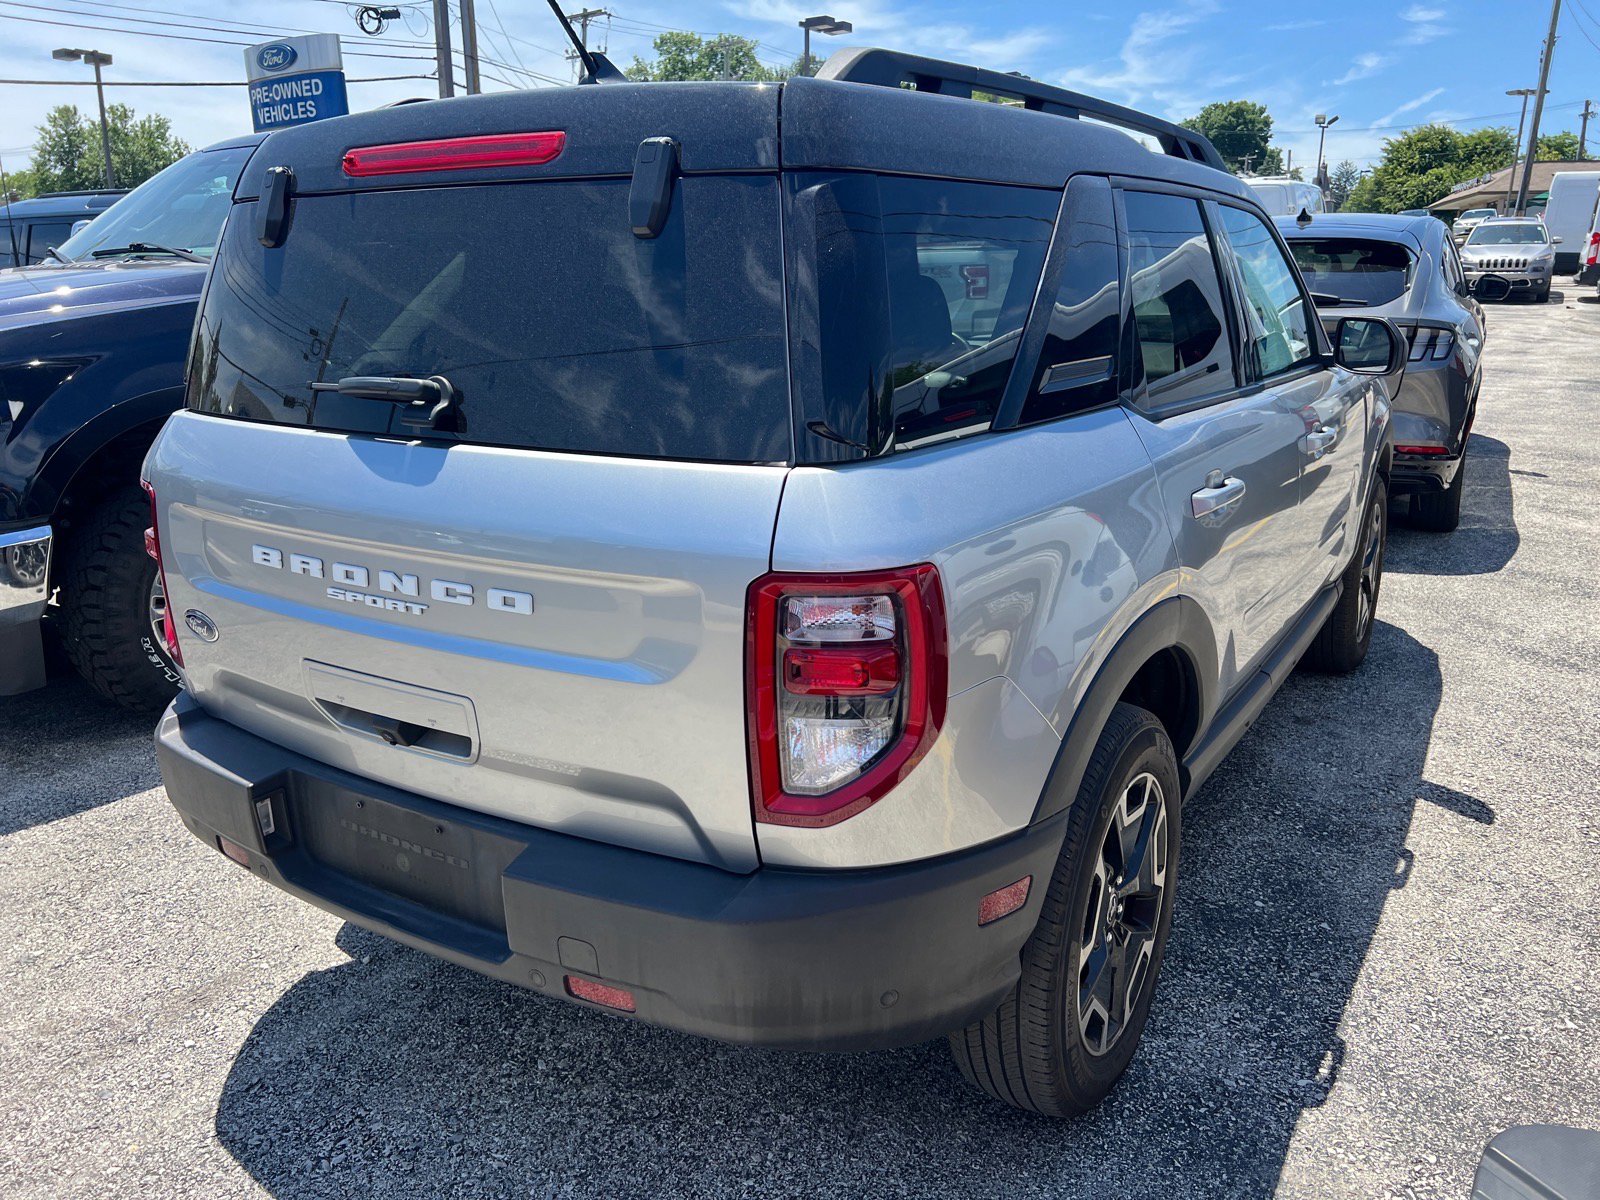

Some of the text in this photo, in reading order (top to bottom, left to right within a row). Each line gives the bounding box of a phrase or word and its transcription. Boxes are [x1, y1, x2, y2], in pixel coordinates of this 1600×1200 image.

[263, 49, 284, 66] Ford
[251, 78, 323, 105] PRE-OWNED
[258, 101, 317, 124] VEHICLES
[252, 544, 534, 615] BRONCO
[326, 586, 429, 615] SPORT
